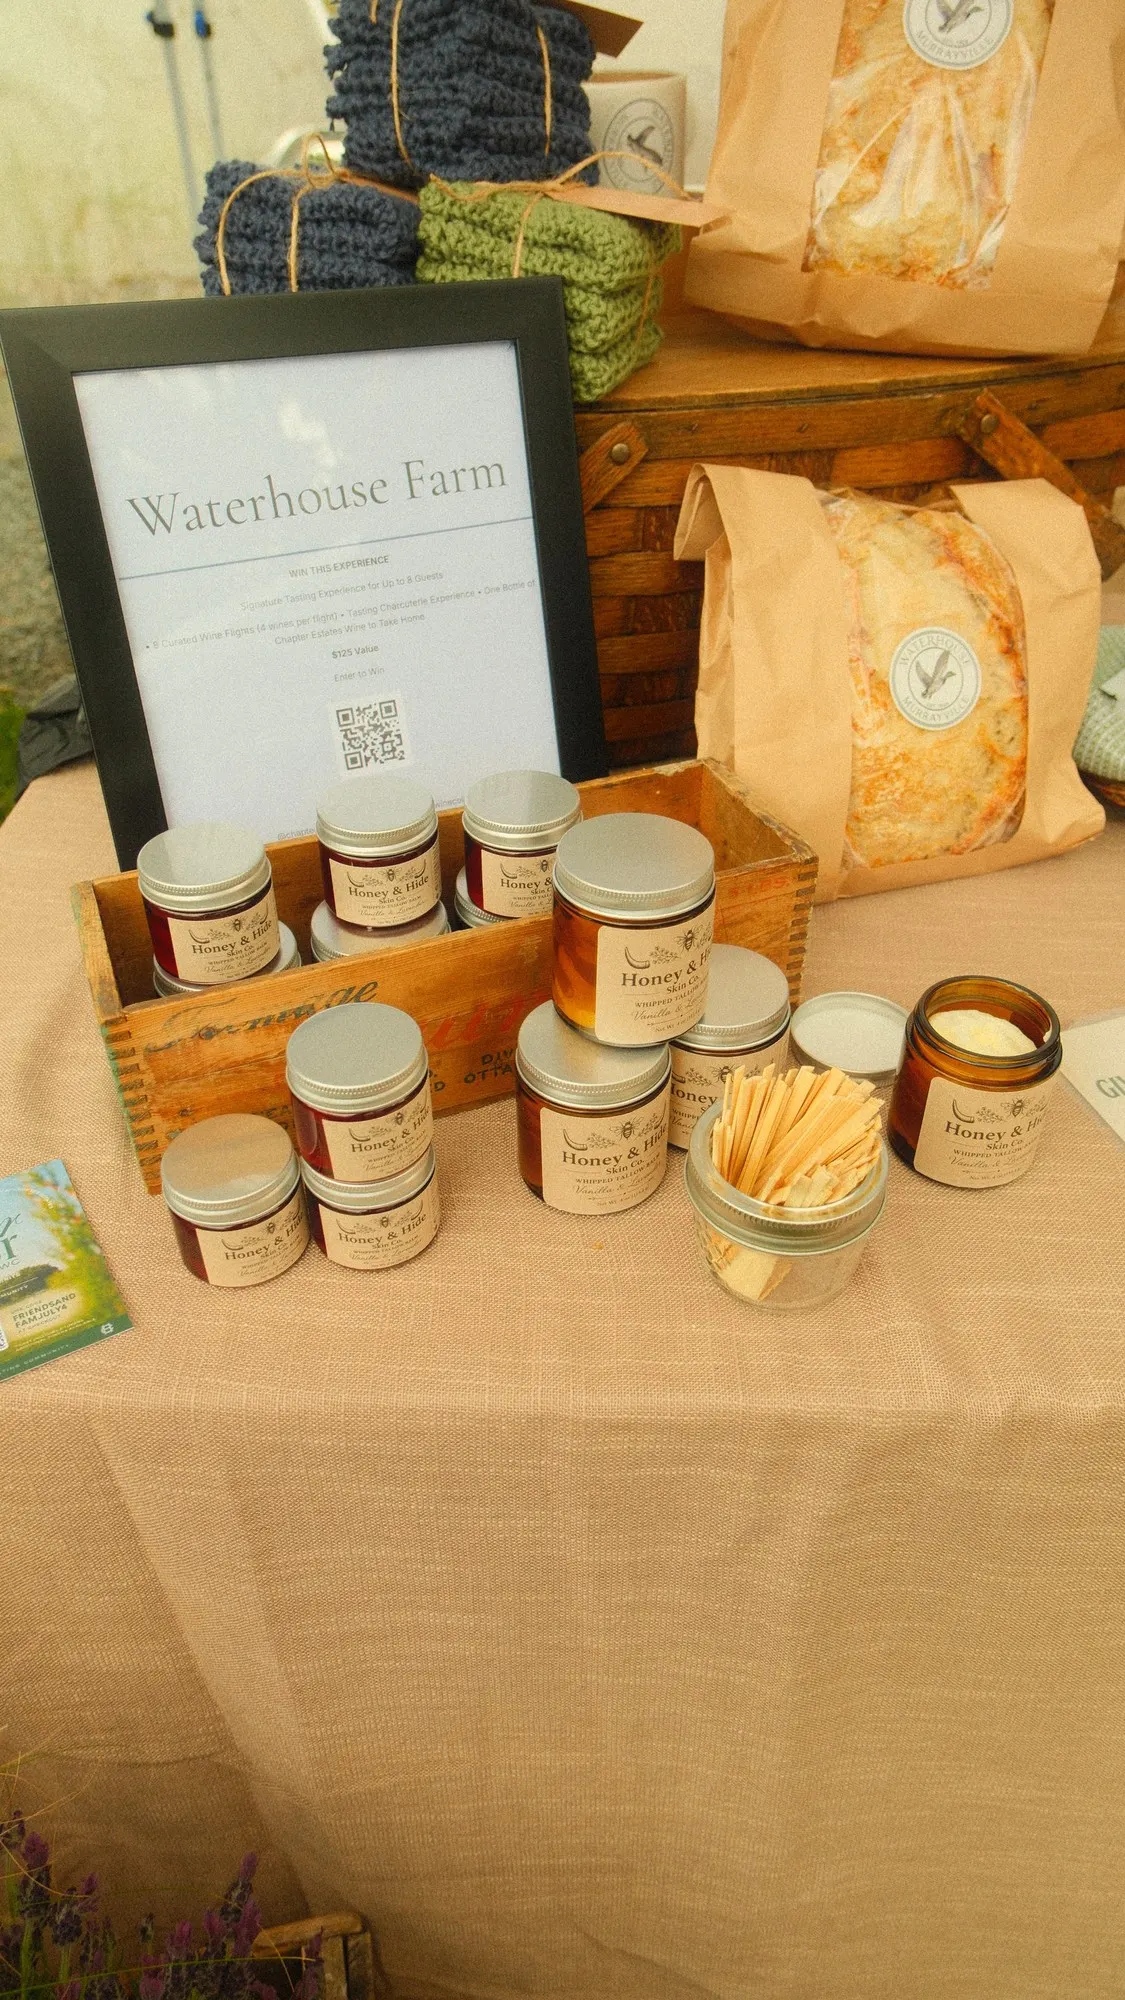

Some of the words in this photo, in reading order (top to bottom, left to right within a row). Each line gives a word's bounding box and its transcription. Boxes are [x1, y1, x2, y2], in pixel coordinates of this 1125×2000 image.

[126, 474, 390, 536] Waterhouse
[403, 459, 508, 501] Farm
[289, 567, 309, 578] WIN
[311, 563, 332, 575] THIS
[333, 555, 390, 572] EXPERIENCE
[239, 596, 283, 612] Signature
[285, 592, 317, 606] Tasting
[318, 584, 366, 601] Experience
[367, 581, 380, 590] for
[382, 579, 395, 590] Up
[396, 577, 405, 585] to
[406, 575, 413, 585] 8
[414, 571, 444, 583] Guests
[161, 635, 198, 649] Curated
[199, 632, 223, 643] Wine
[224, 626, 256, 641] Flights
[256, 622, 267, 633] (4
[268, 620, 295, 631] wines
[296, 617, 311, 629] per
[312, 612, 339, 627] flight)
[348, 606, 379, 619] Tasting
[379, 596, 429, 613] Charcuterie
[430, 589, 476, 605] Experience
[483, 585, 501, 596] One
[502, 580, 526, 592] Bottle
[527, 578, 537, 588] of
[274, 633, 309, 647] Chapter
[311, 627, 343, 640] Estates
[345, 622, 366, 634] Wine
[367, 620, 377, 629] to
[378, 616, 399, 627] Take
[400, 613, 425, 625] Home
[331, 648, 353, 660] $125
[354, 644, 380, 655] Value
[334, 672, 356, 683] Enter
[357, 670, 367, 680] to
[368, 666, 385, 677] Win
[902, 696, 970, 722] MURRAYVILLE
[348, 886, 389, 900] Honey
[392, 886, 403, 896] &
[405, 875, 429, 893] Hide
[500, 878, 541, 889] Honey
[544, 876, 553, 887] &
[378, 896, 395, 905] Skin
[530, 888, 546, 896] Skin
[192, 941, 237, 955] Honey
[240, 935, 250, 946] &
[252, 920, 272, 940] Hide
[226, 948, 243, 958] Skin
[621, 968, 683, 987] Honey
[686, 960, 697, 975] &
[666, 982, 687, 995] Skin
[634, 998, 673, 1009] WHIPPED
[633, 1006, 671, 1022] Vanilla
[463, 1064, 513, 1084] OTTA
[351, 1136, 398, 1153] Honey
[401, 1128, 411, 1139] &
[412, 1105, 430, 1130] Hide
[945, 1120, 1007, 1143] Honey
[1010, 1125, 1023, 1138] &
[387, 1143, 404, 1153] Skin
[953, 1148, 992, 1158] WHIPPED
[994, 1147, 1022, 1158] TALLOW
[985, 1143, 1009, 1151] Skin
[562, 1151, 623, 1168] Honey
[627, 1146, 640, 1160] &
[949, 1155, 988, 1168] Vanilla
[605, 1165, 628, 1175] Skin
[630, 1159, 645, 1168] Co.
[616, 1165, 645, 1181] TALLOW
[572, 1185, 614, 1195] Vanilla
[224, 1243, 271, 1261] Honey
[274, 1235, 284, 1246] &
[285, 1210, 304, 1237] Hide
[338, 1232, 384, 1246] Honey
[387, 1231, 398, 1241] &
[401, 1213, 427, 1236] Hide
[260, 1249, 277, 1259] Skin
[371, 1242, 390, 1250] Skin
[12, 1292, 77, 1322] FRIENDSAND
[15, 1303, 68, 1329] FAMJULY4
[23, 1344, 69, 1365] COMMUNITY
